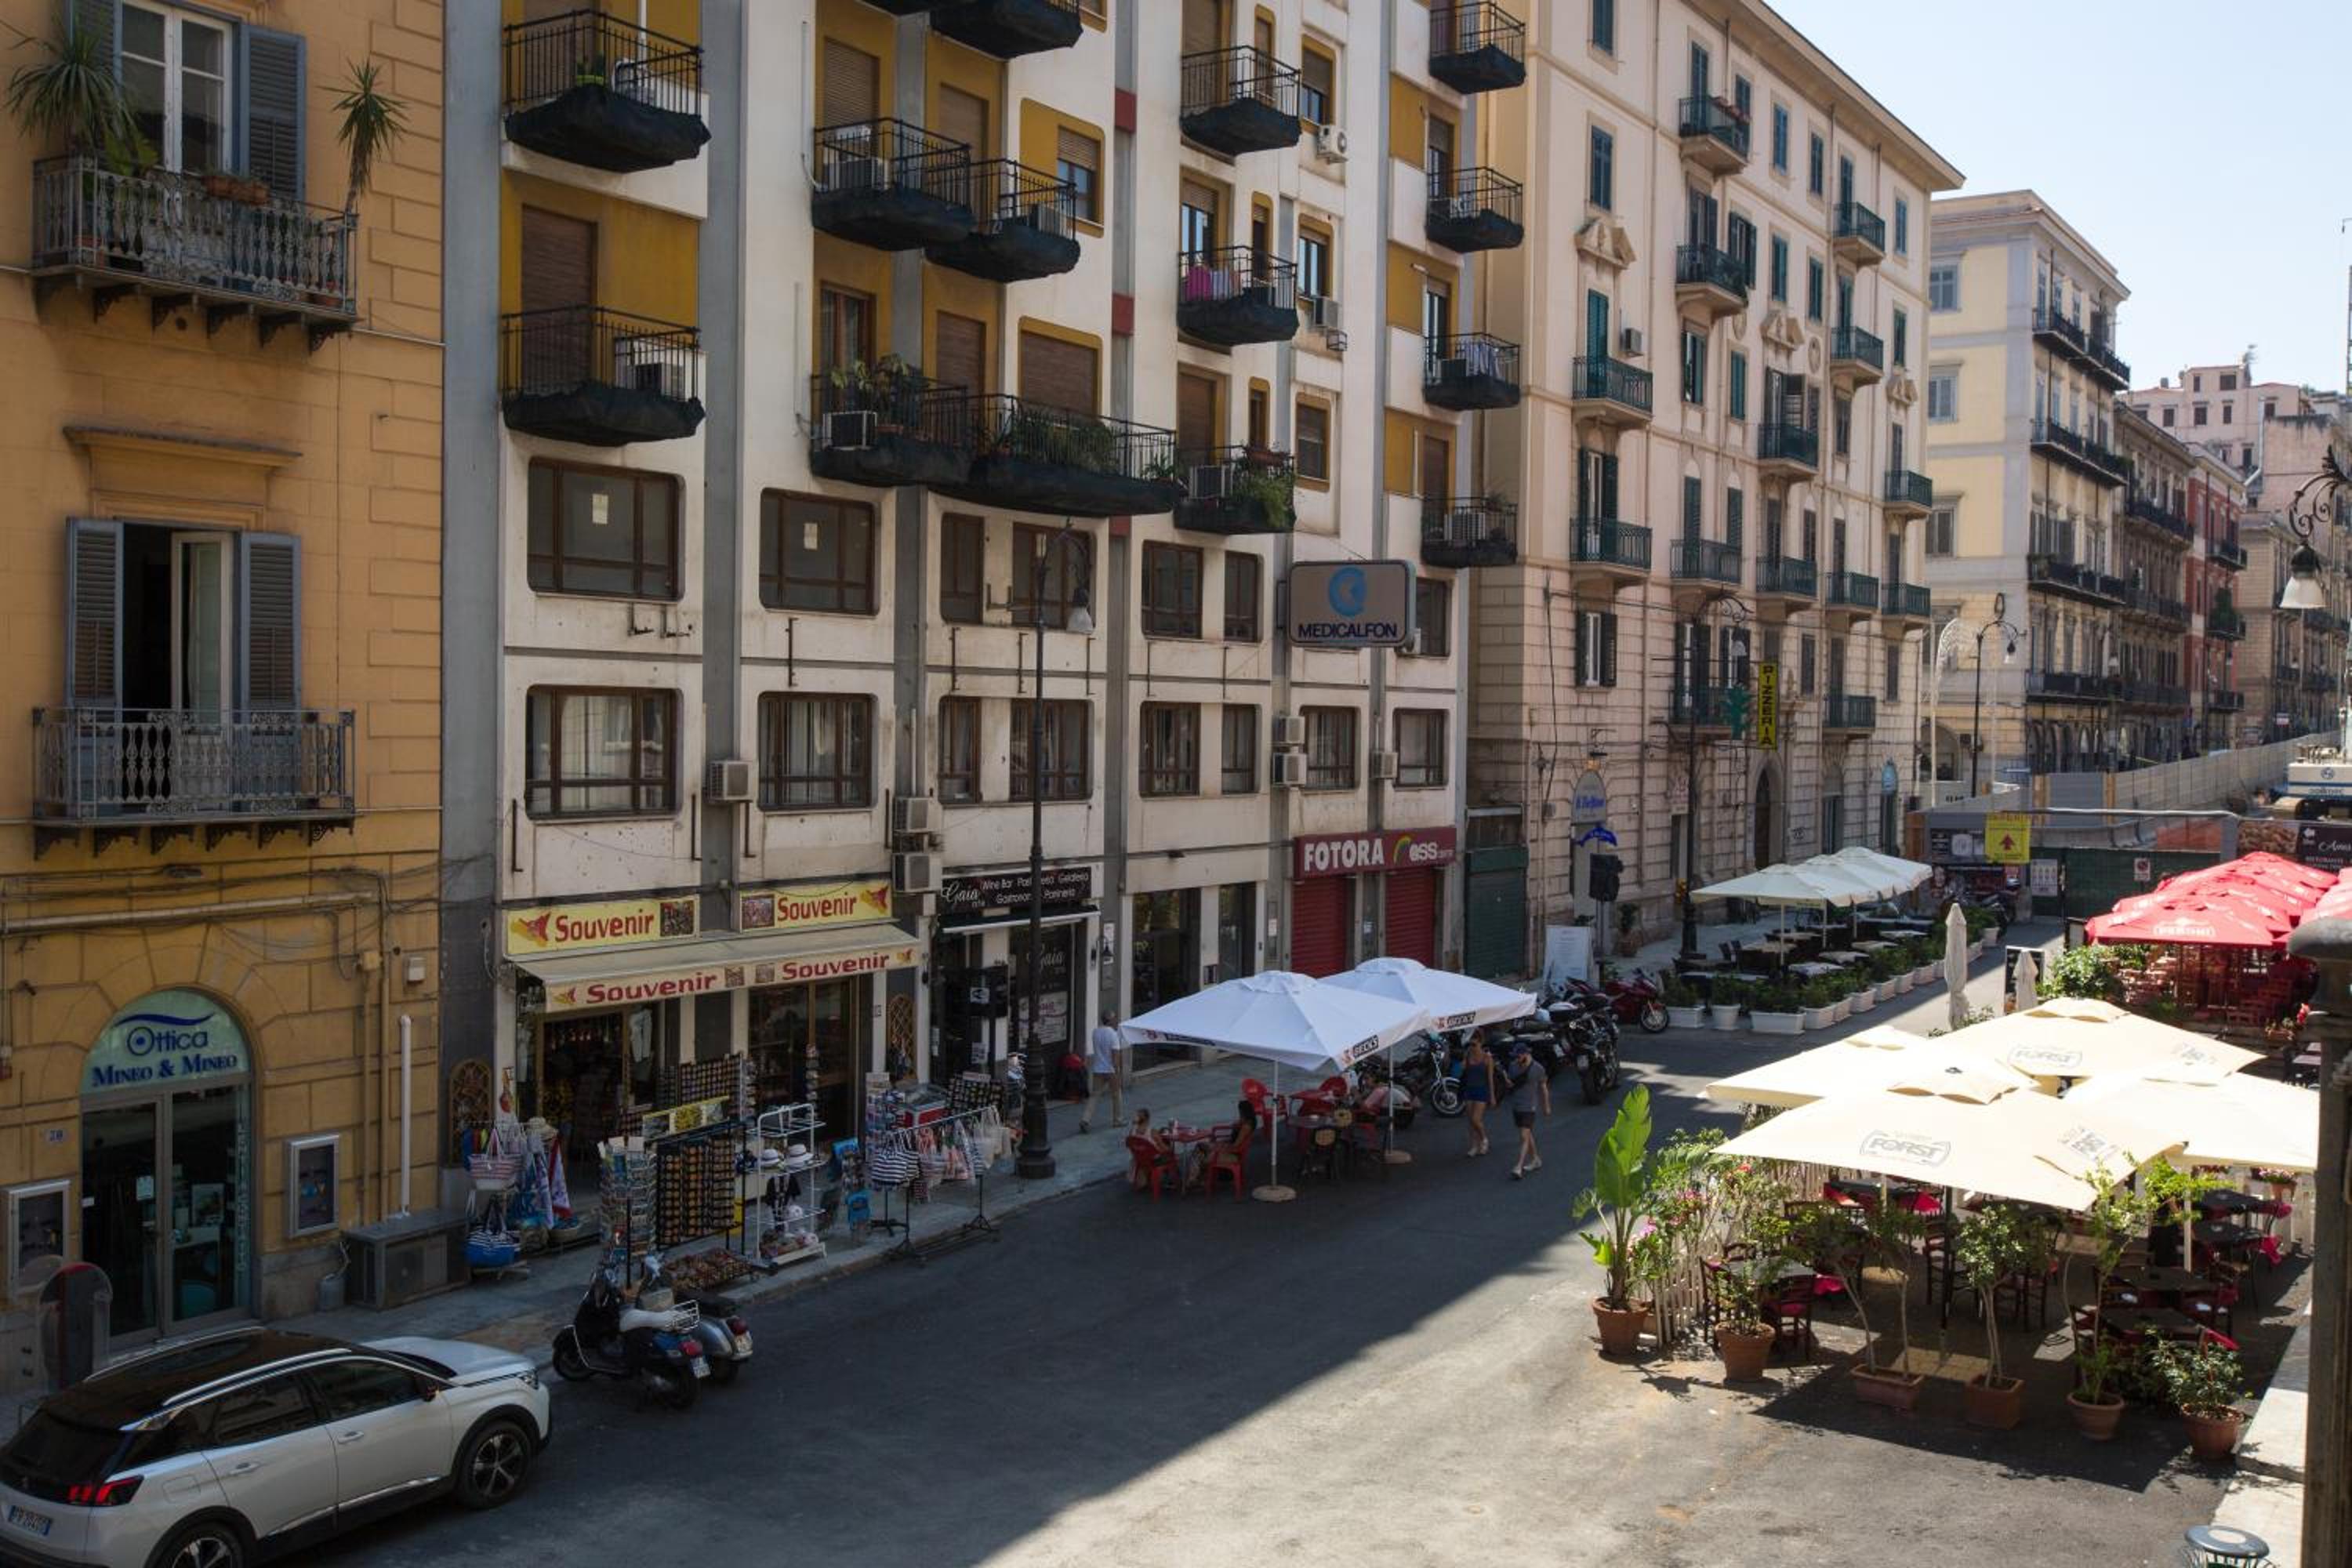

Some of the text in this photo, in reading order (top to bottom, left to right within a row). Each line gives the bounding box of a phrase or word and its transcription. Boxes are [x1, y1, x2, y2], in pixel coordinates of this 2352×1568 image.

[1298, 622, 1397, 638] MEDICALFON
[1762, 666, 1774, 746] PIZZERIA
[1304, 838, 1385, 872] FOTORA
[777, 891, 857, 921] Souvenir
[942, 880, 981, 905] Gaia
[554, 908, 655, 942] Souvenir
[782, 952, 890, 980] Souvenir
[586, 972, 717, 1004] Souvenir
[127, 1026, 208, 1056] Ottica
[159, 1059, 174, 1077] &
[1869, 1138, 1945, 1159] FORST
